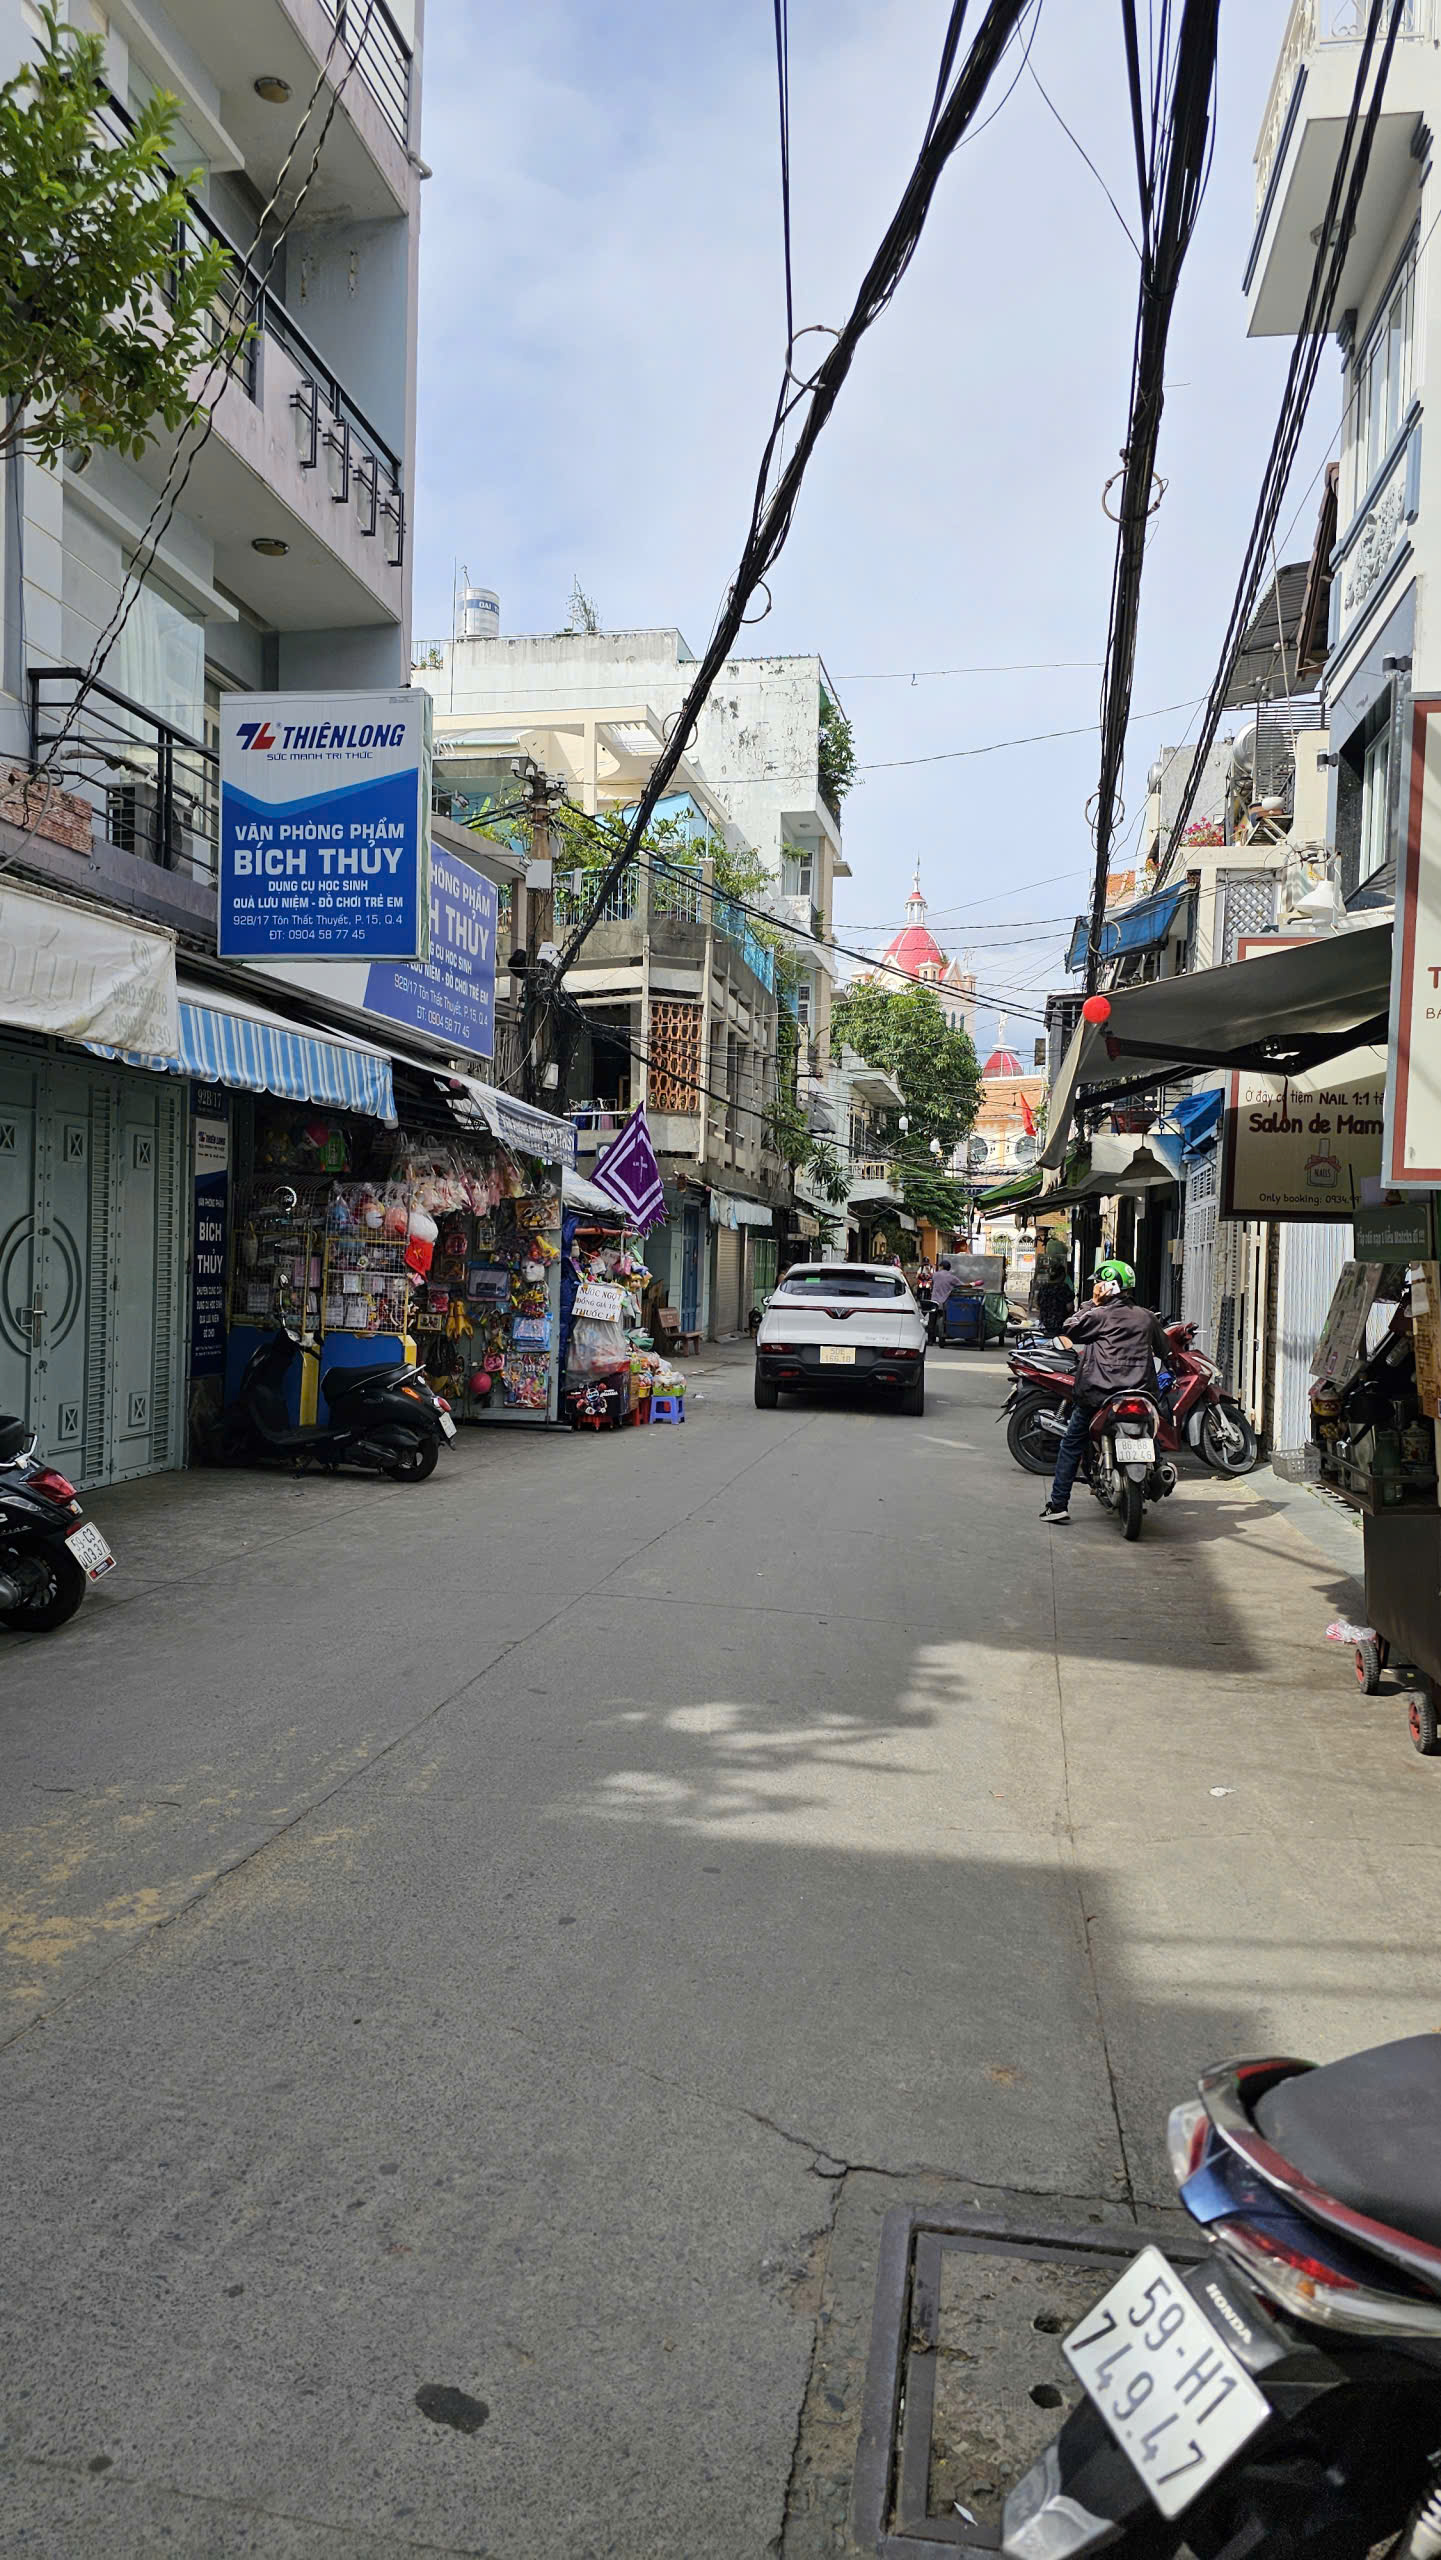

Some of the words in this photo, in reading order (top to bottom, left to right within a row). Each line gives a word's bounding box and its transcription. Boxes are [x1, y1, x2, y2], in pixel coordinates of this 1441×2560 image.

[325, 752, 342, 760] TRI
[234, 823, 273, 841] VĂN
[279, 820, 344, 840] PHÒNG
[350, 817, 404, 840] PHẨM
[234, 842, 306, 875] BÍCH
[318, 840, 403, 875] THỦY
[268, 880, 298, 894] DỤNG
[301, 881, 315, 894] CỤ
[318, 880, 340, 893] HỌC
[342, 880, 368, 891] SINH
[431, 862, 460, 899] HÒNG
[233, 896, 255, 909] QUÀ
[258, 897, 278, 908] LƯU
[281, 895, 309, 911] NIỆM
[318, 892, 333, 908] ĐỒ
[336, 896, 360, 908] CHƠI
[364, 894, 384, 908] TRẺ
[387, 897, 403, 907] EM
[233, 915, 269, 926] 92B/17
[272, 915, 289, 925] Tôn
[291, 914, 314, 925] Thất
[269, 930, 285, 940] ĐT:
[288, 930, 315, 940] 0904
[318, 930, 332, 940] 58
[335, 929, 349, 939] 77
[352, 929, 366, 939] 45
[445, 904, 489, 961] THỦY
[428, 1009, 444, 1028] 0904
[444, 1017, 453, 1032] 58
[453, 1020, 461, 1035] 77
[462, 1024, 470, 1039] 45
[1255, 1090, 1273, 1107] đây
[1290, 1090, 1313, 1104] tiệm
[1319, 1091, 1348, 1105] NAIL
[1352, 1092, 1370, 1105] 1:1
[1249, 1112, 1303, 1133] Salon
[1308, 1112, 1331, 1133] de
[1337, 1114, 1384, 1134] Mam
[1259, 1193, 1281, 1205] Only
[1284, 1193, 1322, 1206] booking:
[199, 1216, 222, 1241] BÍCH
[197, 1249, 223, 1274] THỦY
[1205, 2283, 1252, 2345] HONDA
[1129, 2276, 1238, 2425] 59-H1
[1072, 2309, 1206, 2485] 749.47
